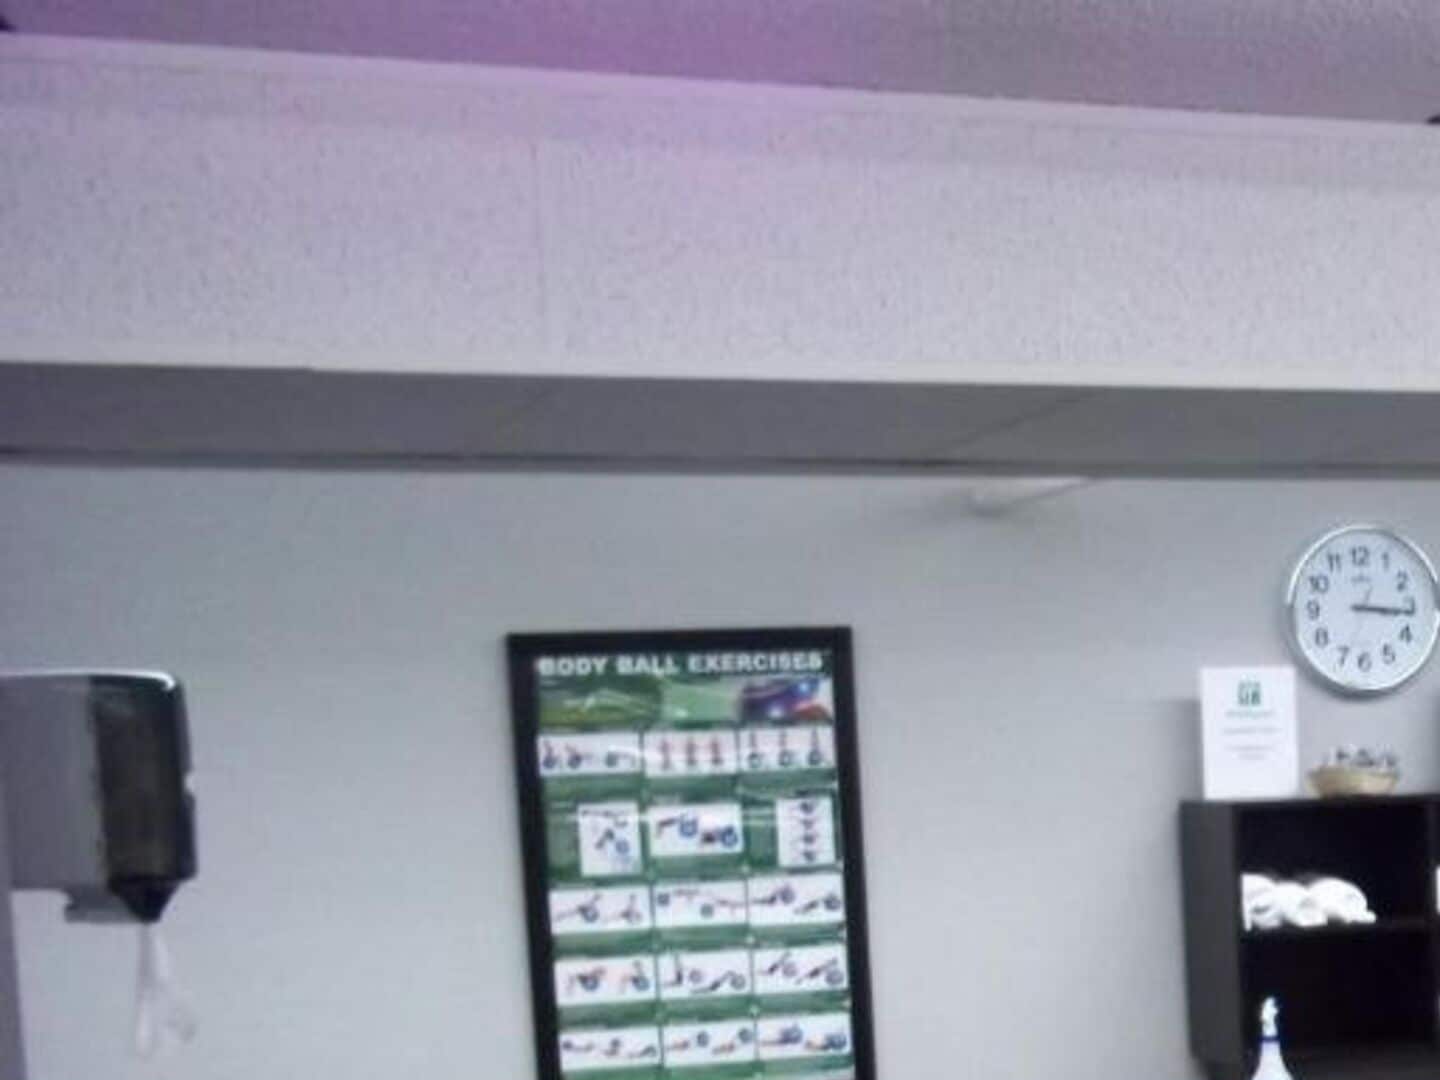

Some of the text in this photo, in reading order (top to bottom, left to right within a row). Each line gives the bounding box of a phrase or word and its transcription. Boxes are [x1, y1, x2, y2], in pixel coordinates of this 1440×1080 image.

[1327, 552, 1342, 573] 11
[1351, 546, 1370, 566] 12
[1381, 552, 1390, 571] 1
[1309, 573, 1329, 594] 10
[1397, 570, 1408, 592] 2
[1306, 600, 1320, 621] 9
[1314, 627, 1329, 648] 8
[1399, 624, 1412, 645] 4
[536, 651, 824, 676] BODY BALL EXERCISES
[1338, 645, 1350, 667] 7
[1357, 652, 1372, 673] 6
[1382, 643, 1396, 665] 5
